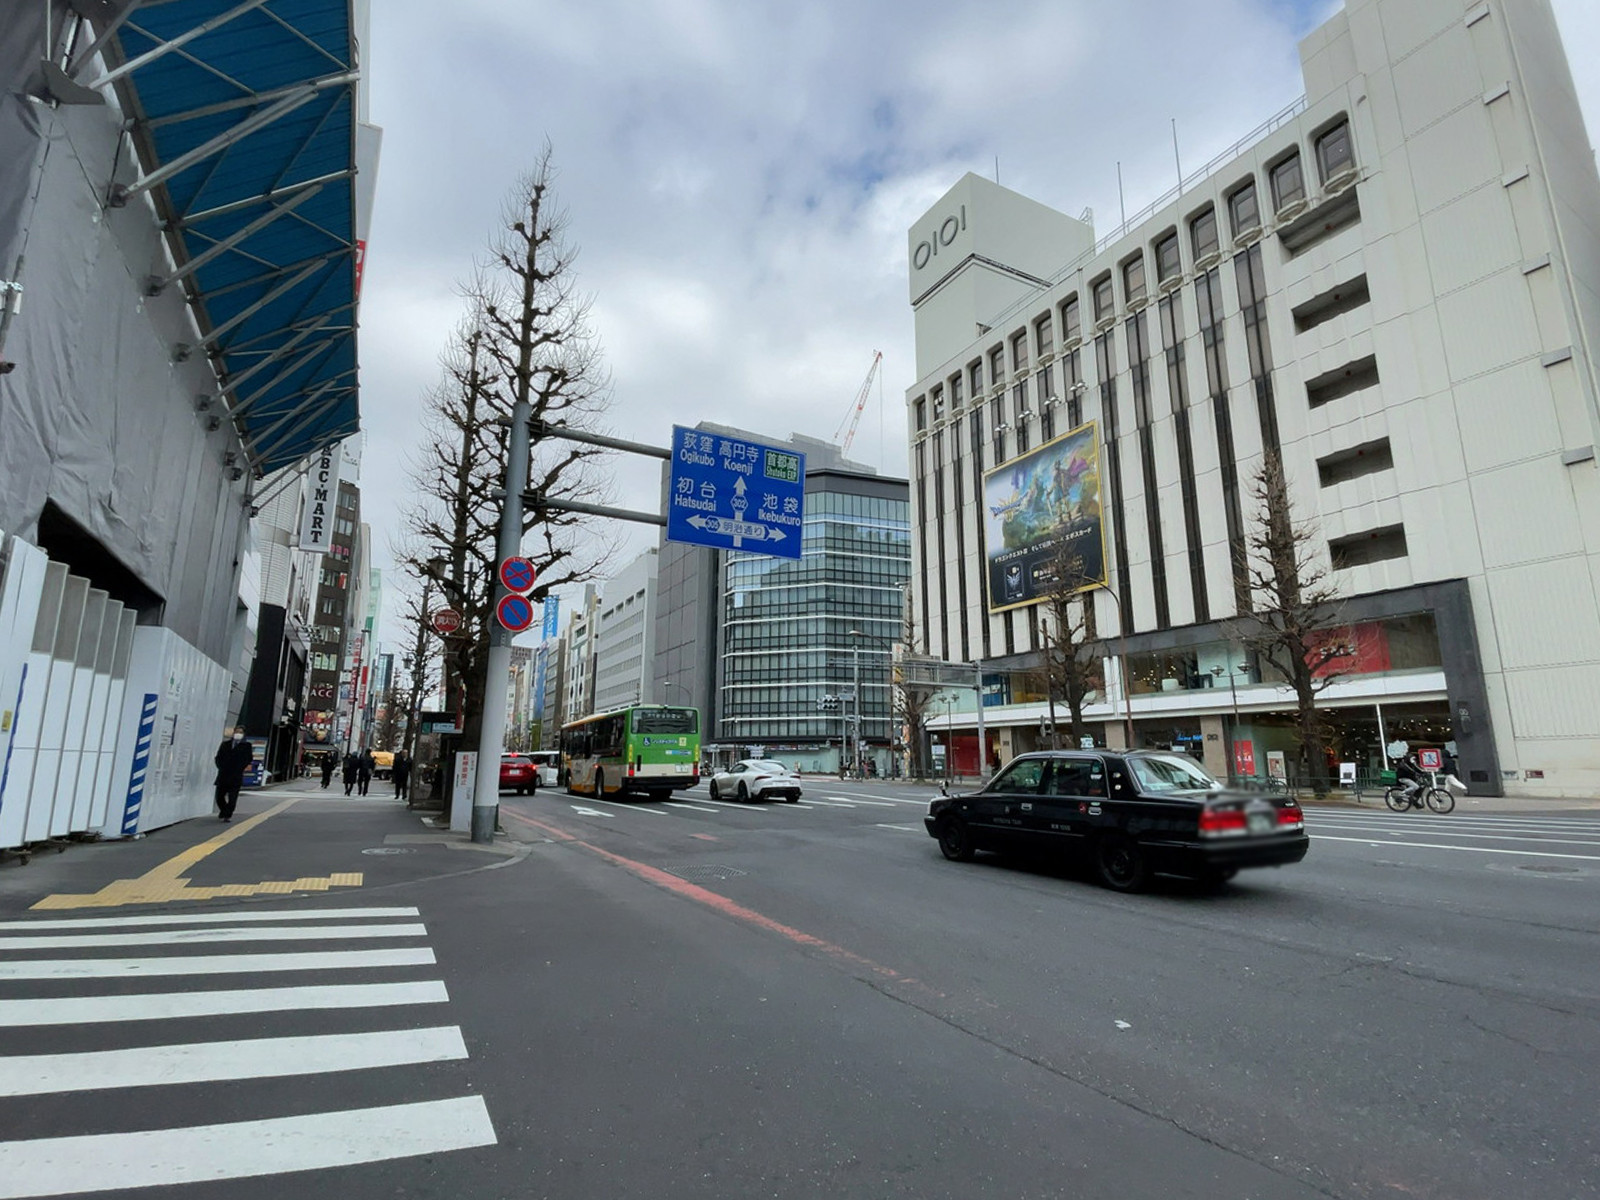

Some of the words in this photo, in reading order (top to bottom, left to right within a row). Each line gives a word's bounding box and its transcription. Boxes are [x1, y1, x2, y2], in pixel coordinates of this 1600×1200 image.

[683, 432, 714, 454] 荻窪
[719, 440, 759, 463] 高円寺
[680, 448, 715, 466] Ogikubo
[724, 457, 753, 476] Koenji
[767, 452, 798, 472] 首都高
[676, 476, 717, 499] 初台
[674, 493, 717, 512] Hatsudai
[733, 497, 747, 509] 302
[762, 493, 799, 514] 池袋
[706, 519, 720, 530] 305
[758, 508, 801, 527] Ikebukuro
[723, 521, 764, 536] 明治通り
